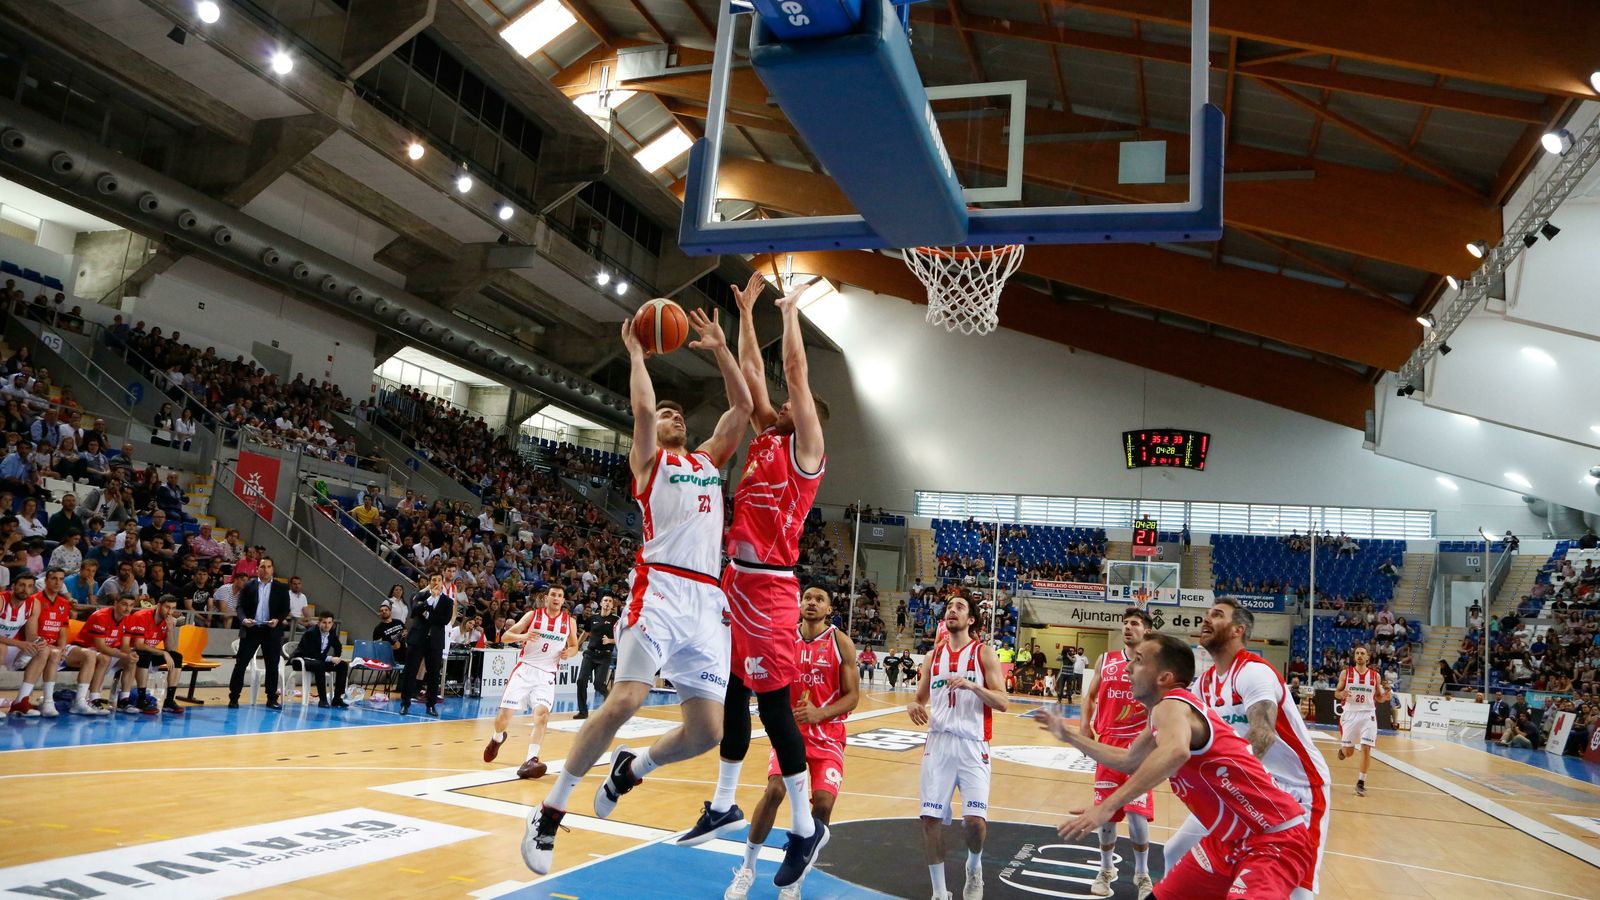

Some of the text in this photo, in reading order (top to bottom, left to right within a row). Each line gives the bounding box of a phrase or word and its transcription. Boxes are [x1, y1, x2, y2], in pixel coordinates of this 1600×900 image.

[43, 335, 60, 350] 05
[1173, 435, 1183, 444] 33
[1155, 446, 1176, 455] 04:28
[1135, 520, 1157, 530] 04:28
[1136, 530, 1156, 545] 21
[1169, 593, 1205, 602] VRGER
[1071, 608, 1124, 623] Ajuntam
[1172, 614, 1191, 627] de
[541, 643, 549, 653] 9
[800, 649, 813, 664] 14
[701, 671, 728, 688] asisa
[948, 690, 956, 708] 11
[1355, 694, 1365, 703] 26
[185, 820, 400, 864] GRAN
[226, 837, 370, 869] restaurant
